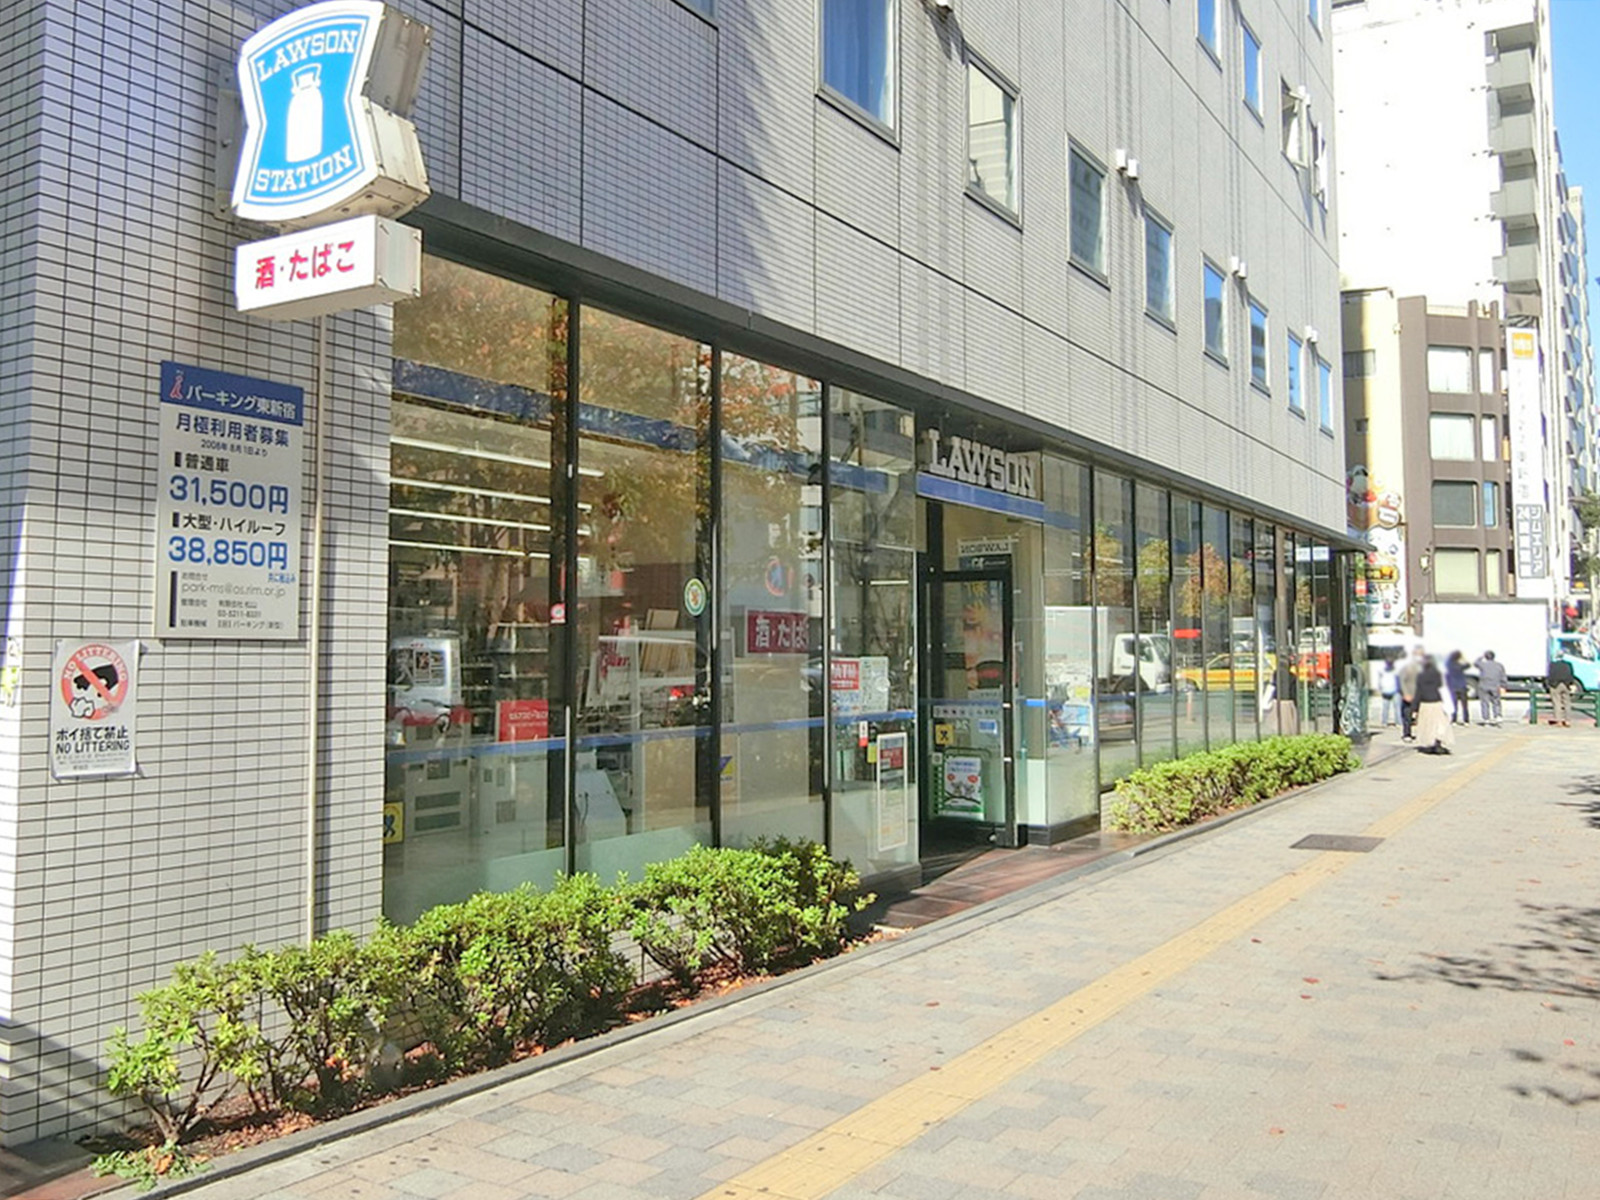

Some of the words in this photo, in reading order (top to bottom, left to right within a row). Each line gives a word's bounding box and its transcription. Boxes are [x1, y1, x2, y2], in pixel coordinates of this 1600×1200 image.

[258, 30, 359, 82] LAWSON
[254, 145, 354, 193] STATION
[255, 240, 355, 290] 酒・たばこ
[186, 384, 297, 421] パーキング東新宿
[176, 412, 290, 448] 月極利用者募集
[185, 452, 230, 473] 普通車
[928, 428, 1037, 498] LAWSON
[169, 474, 289, 514] 31,500円
[183, 512, 286, 537] 大型・ハイルーフ
[168, 535, 288, 570] 38,850円
[55, 742, 72, 755] NO
[75, 740, 130, 754] LITTERING
